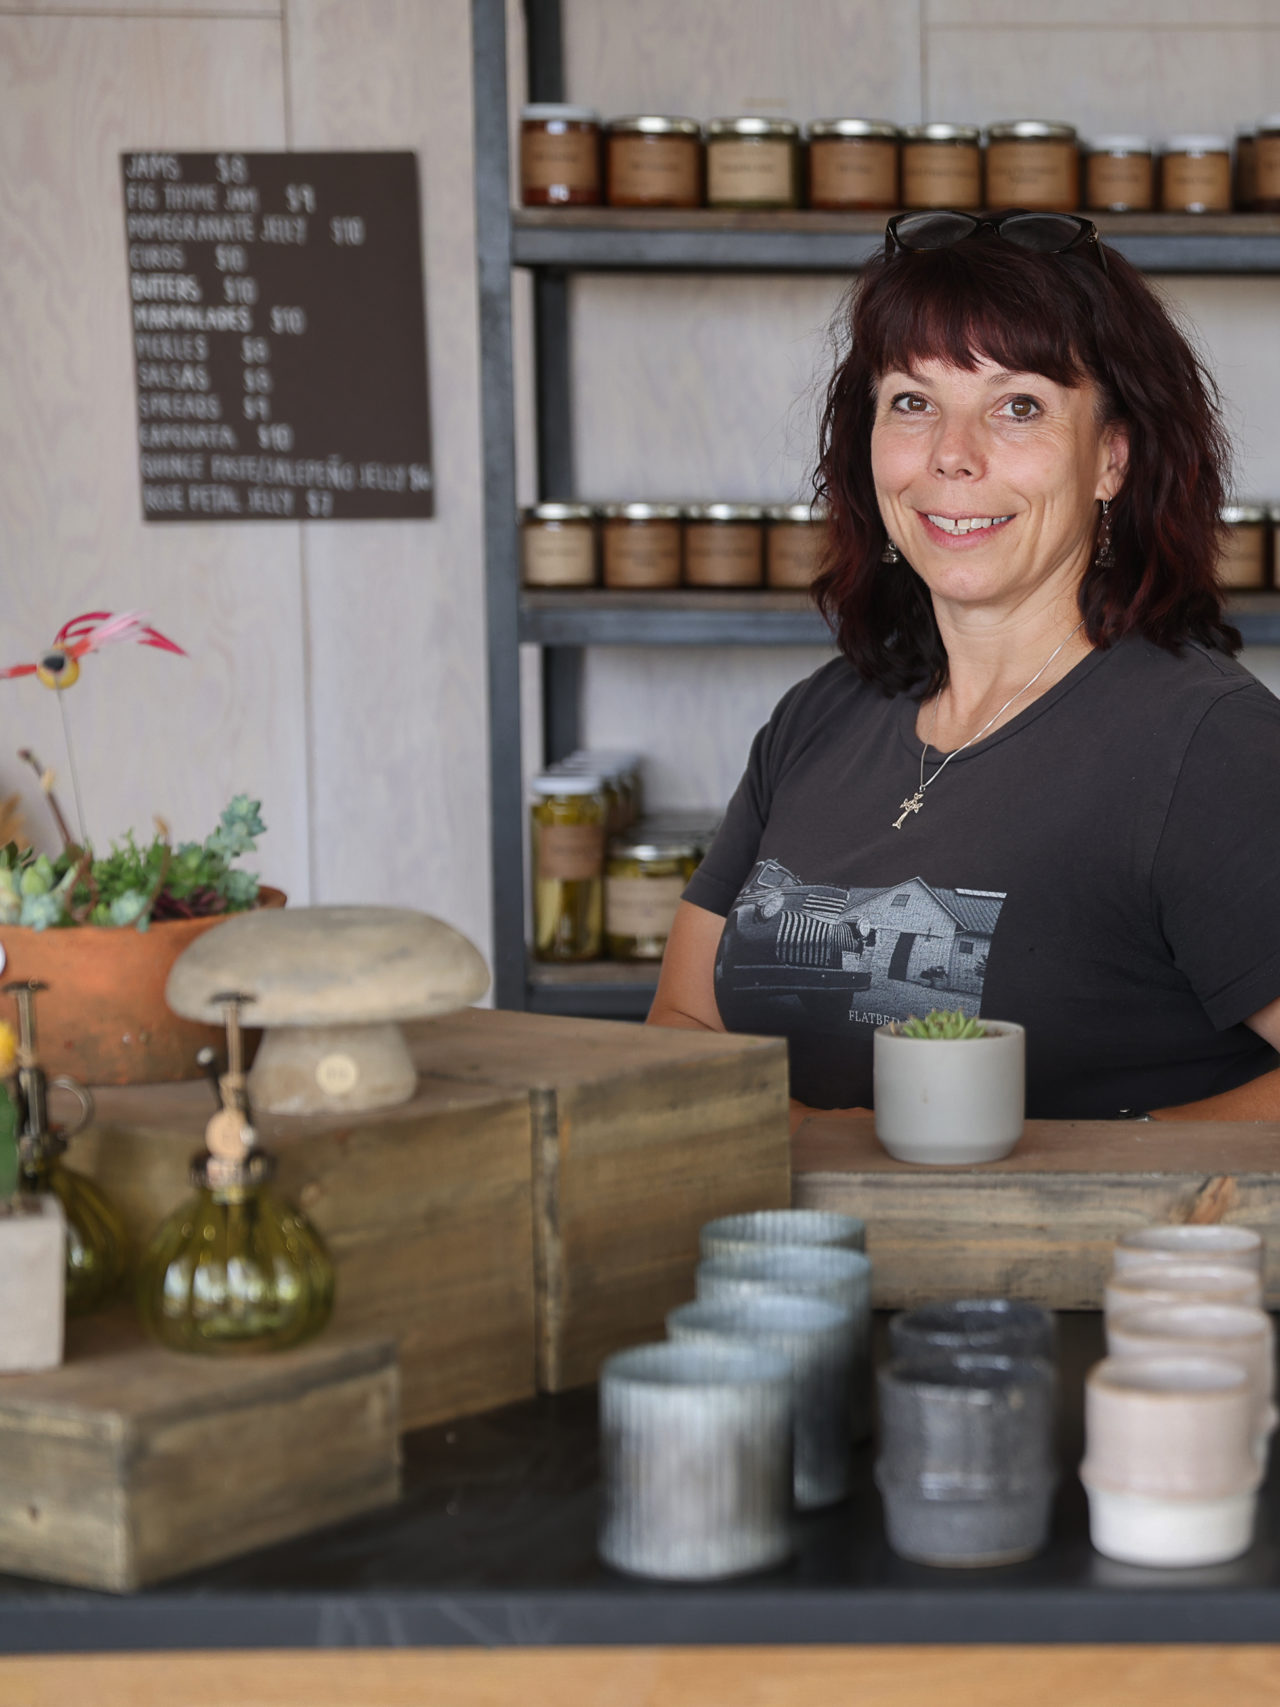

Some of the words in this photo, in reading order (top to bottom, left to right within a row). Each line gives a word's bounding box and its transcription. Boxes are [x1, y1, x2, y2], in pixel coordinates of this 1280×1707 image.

[126, 154, 179, 179] JAMS
[128, 212, 255, 242] POMEGRANATE
[260, 214, 306, 246] JELLY
[131, 273, 201, 302] BUTTERS
[133, 304, 252, 333] MARMALADES
[138, 362, 210, 391] SALSAS
[138, 392, 221, 420] SPREADS
